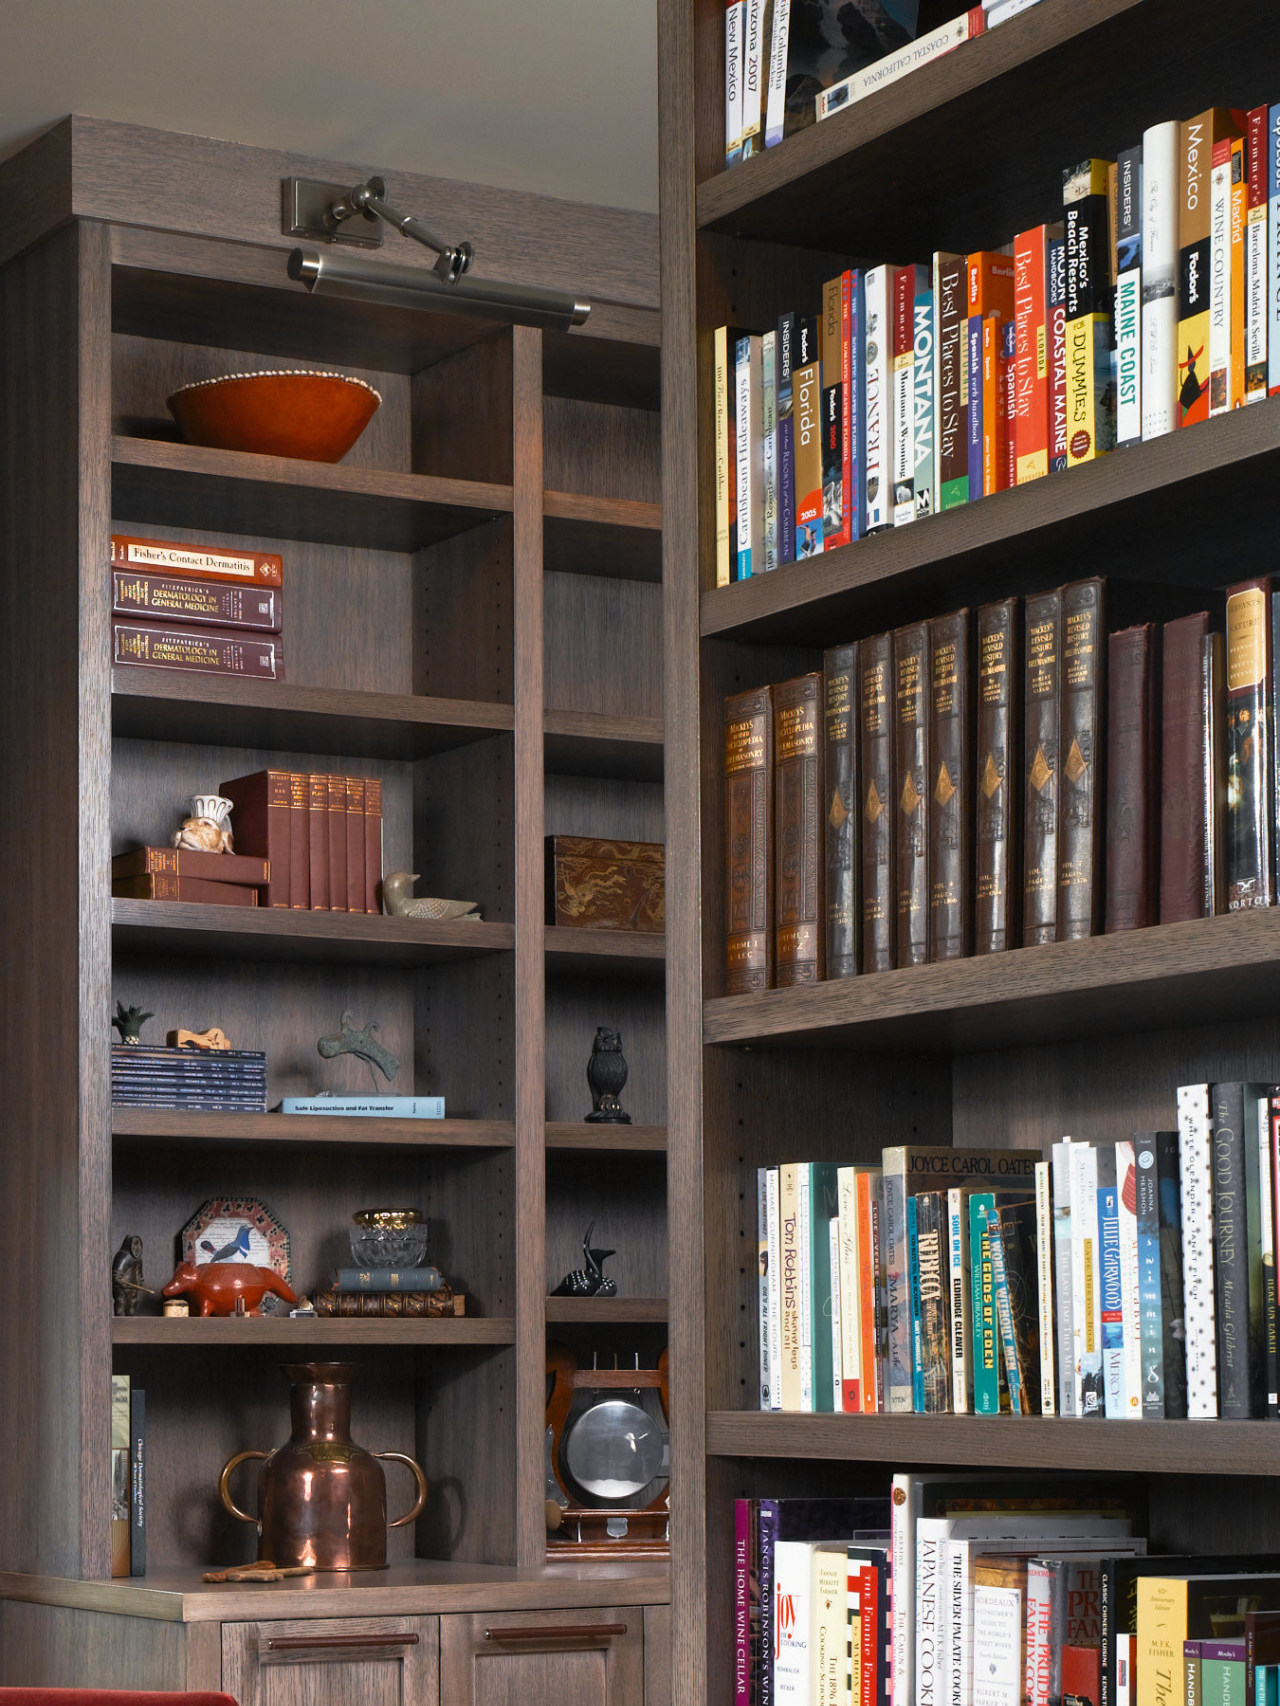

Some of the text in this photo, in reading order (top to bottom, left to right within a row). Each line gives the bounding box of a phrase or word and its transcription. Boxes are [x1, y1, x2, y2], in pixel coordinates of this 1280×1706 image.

[728, 7, 739, 102] New Mexico
[748, 54, 759, 93] 2007
[863, 54, 911, 88] CALIFORNIA
[1187, 123, 1203, 211] Mexico
[1231, 190, 1242, 244] Madrid
[1067, 210, 1079, 313] Beach Resorts
[1079, 226, 1089, 289] Mexico's
[1214, 198, 1224, 328] WINE COUNTRY
[942, 272, 959, 388] Best Places
[1016, 250, 1032, 355] Best Places
[971, 332, 979, 374] Spanish
[1120, 281, 1136, 405] MAINE COAST
[914, 305, 933, 469] MONTANA
[1006, 363, 1016, 420] Spanish
[1053, 308, 1067, 453] COASTAL MAINE
[1073, 333, 1087, 422] DUMMIES
[799, 368, 816, 447] Florida
[866, 368, 880, 471] FRANCE
[899, 370, 909, 479] Montana Wyoming
[738, 378, 750, 546] Caribbean Hideaways
[800, 509, 817, 521] 2005
[134, 547, 251, 572] Fisher's Contact Dermatitis
[151, 598, 219, 613] GENERAL MEDICINE
[153, 589, 207, 602] DERMATOLOGY
[151, 651, 184, 662] GENERAL
[185, 655, 220, 666] MEDICINE
[153, 643, 208, 656] DERMATOLOGY
[907, 1155, 995, 1175] JOYCE CAROL
[1188, 1156, 1196, 1216] OLEANDER
[1215, 1128, 1236, 1268] GOOD JOURNEY
[1102, 1216, 1119, 1247] JULIE
[784, 1212, 798, 1309] Tom Robbins
[951, 1214, 963, 1359] SOUL ON ICE ELDRIDGE CLEAVER
[1103, 1248, 1122, 1310] GARWOOD
[887, 1277, 899, 1334] MARYA
[973, 1264, 983, 1338] WILLIAM BRAMLEY
[982, 1261, 994, 1369] GODS OF EDEN
[990, 1240, 1017, 1371] WORLD WITHOUT MEN
[1109, 1352, 1120, 1396] MERCY
[737, 1539, 746, 1565] THE
[761, 1529, 769, 1579] JANCIS
[953, 1553, 962, 1579] THE
[737, 1568, 746, 1608] HOME
[922, 1538, 936, 1633] JAPANESE
[953, 1581, 962, 1620] SILVER
[976, 1596, 1015, 1608] BORDEAUX
[737, 1611, 746, 1645] WINE
[762, 1584, 770, 1669] ROBINSON'S
[774, 1582, 802, 1660] joy
[780, 1639, 807, 1649] COOKING
[864, 1606, 874, 1656] Fannie
[952, 1621, 962, 1667] PALATE
[1026, 1597, 1037, 1663] FAMILY
[1037, 1598, 1052, 1634] THE
[736, 1648, 746, 1694] CELLAR
[1148, 1648, 1175, 1658] FISHER
[829, 1676, 837, 1700] 1896
[1155, 1669, 1173, 1706] The
